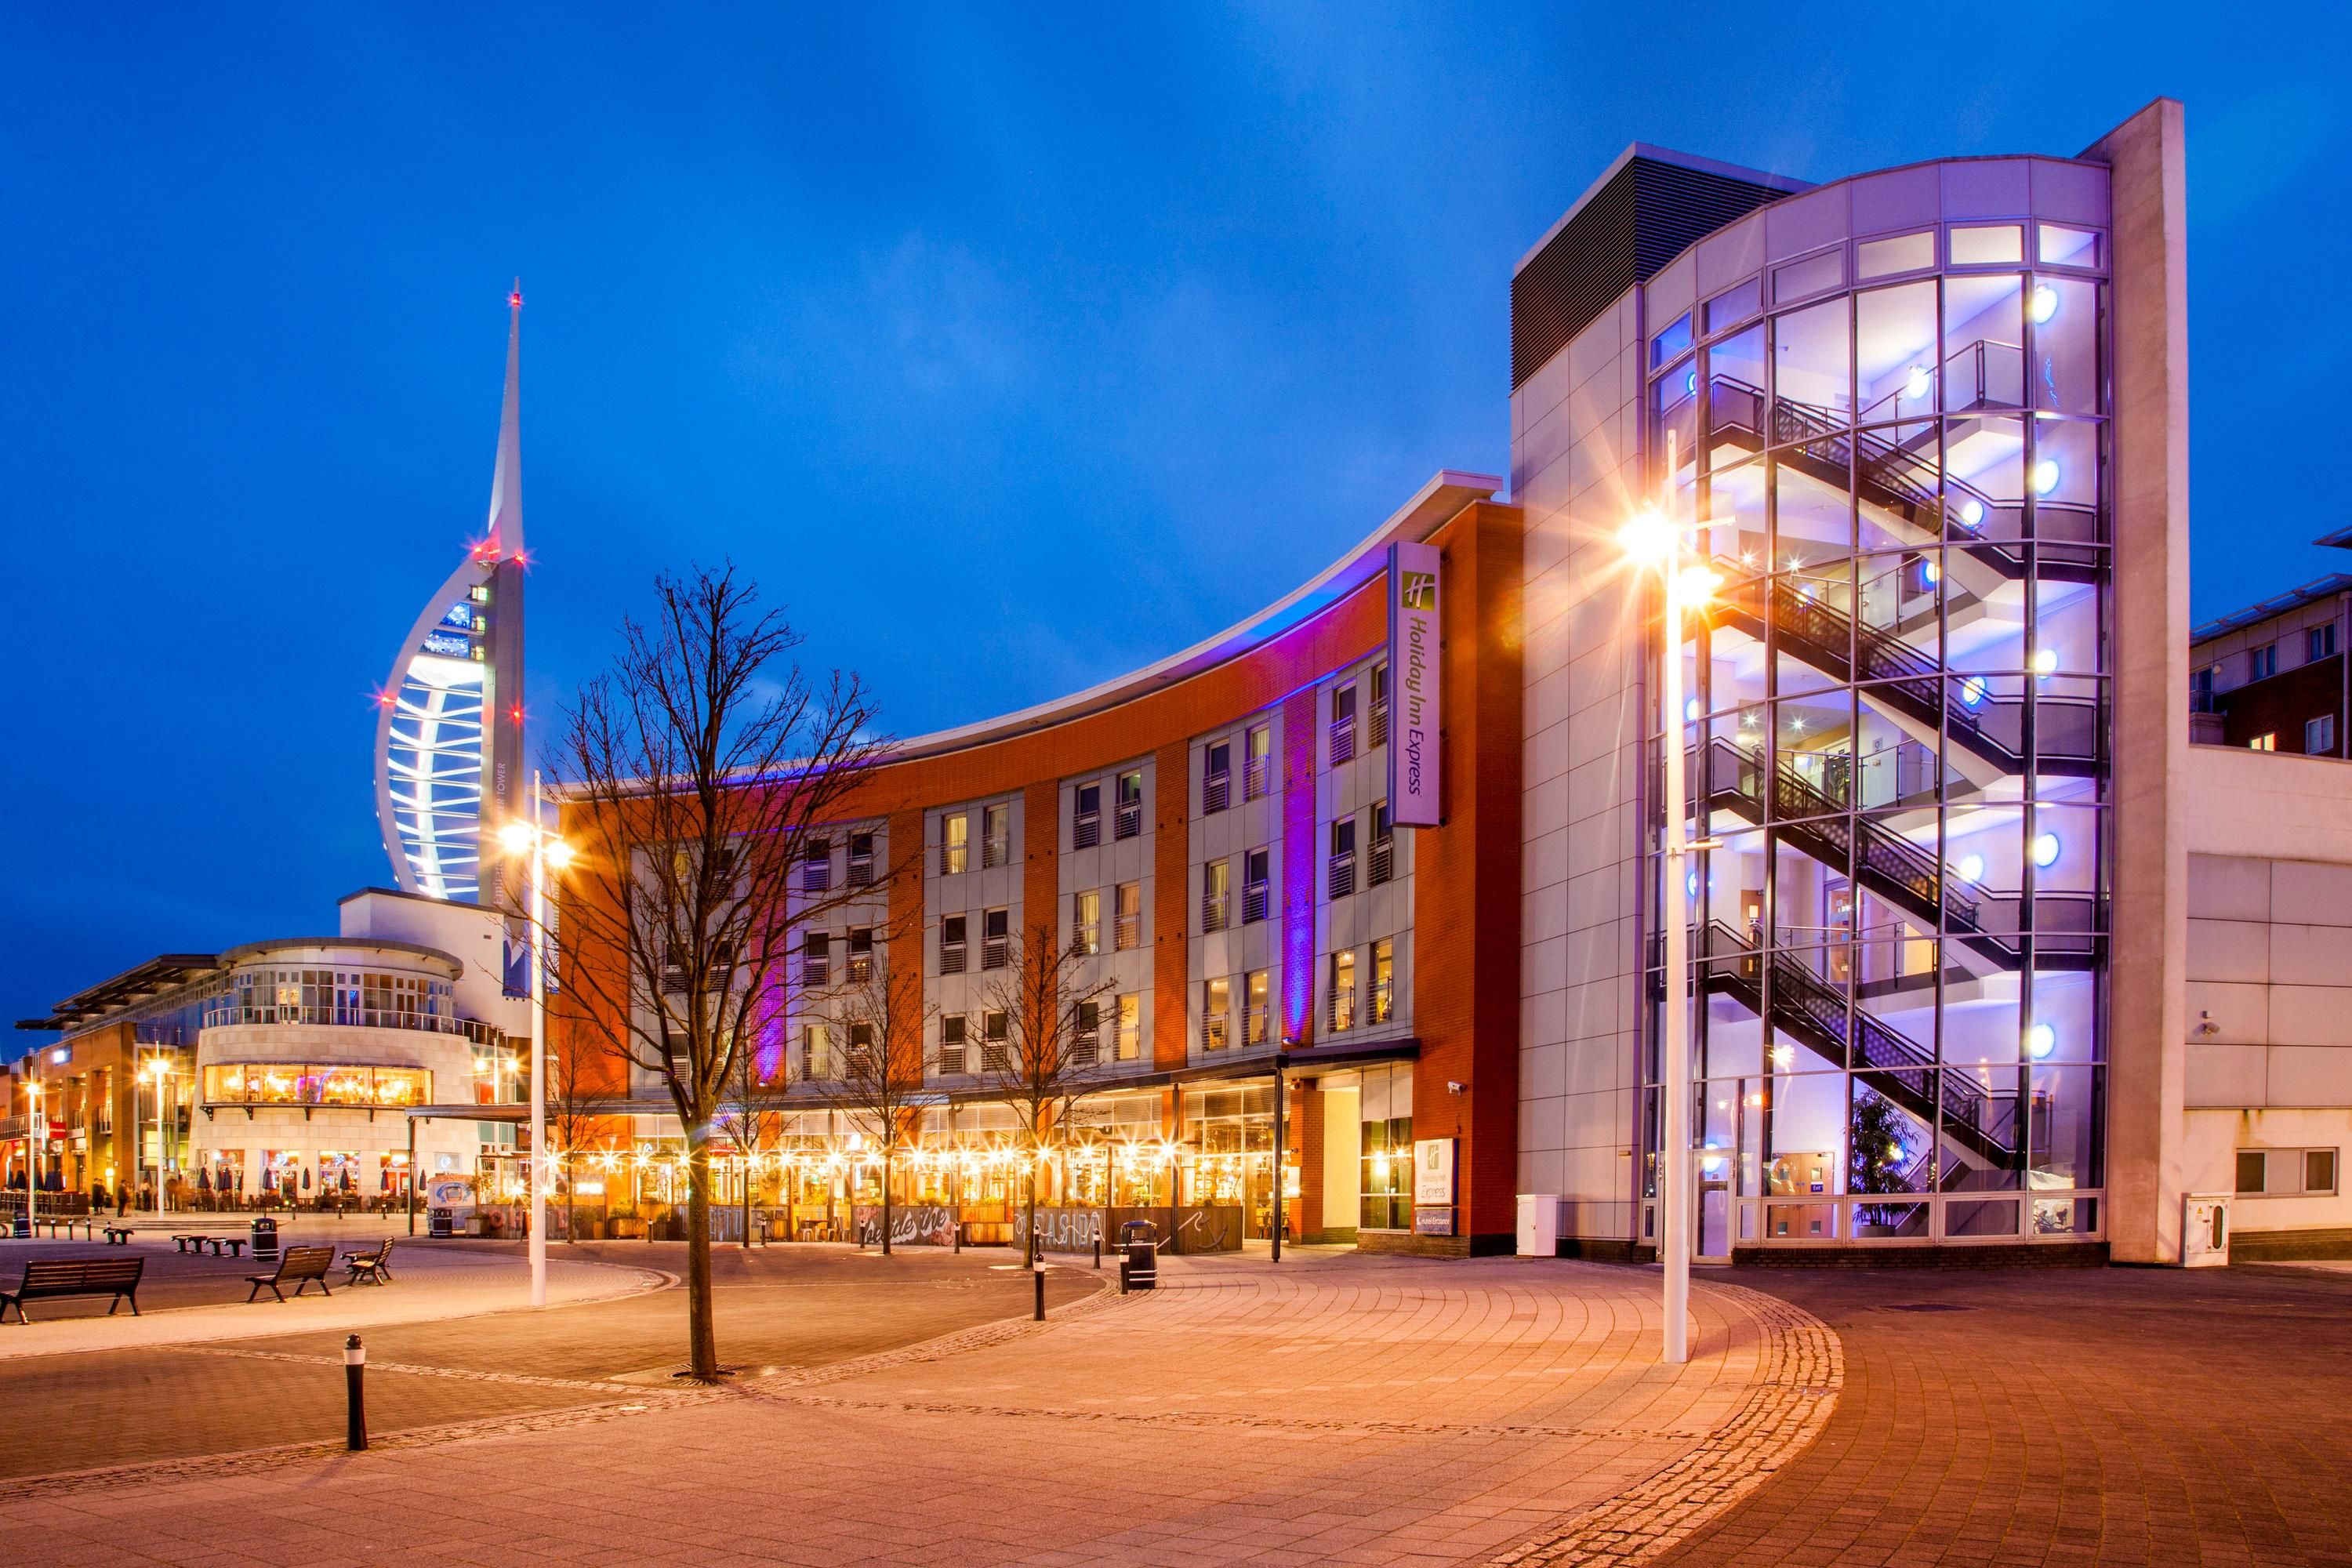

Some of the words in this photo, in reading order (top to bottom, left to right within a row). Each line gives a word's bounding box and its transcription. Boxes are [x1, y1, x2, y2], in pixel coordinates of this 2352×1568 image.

[1406, 616, 1427, 692] Holiday
[1409, 695, 1427, 726] Inn
[1405, 729, 1425, 796] Express
[497, 762, 506, 795] TOWER
[1421, 1185, 1446, 1198] Express
[920, 1207, 950, 1236] the
[1421, 1216, 1432, 1225] Hotel
[1432, 1216, 1450, 1225] Entrance
